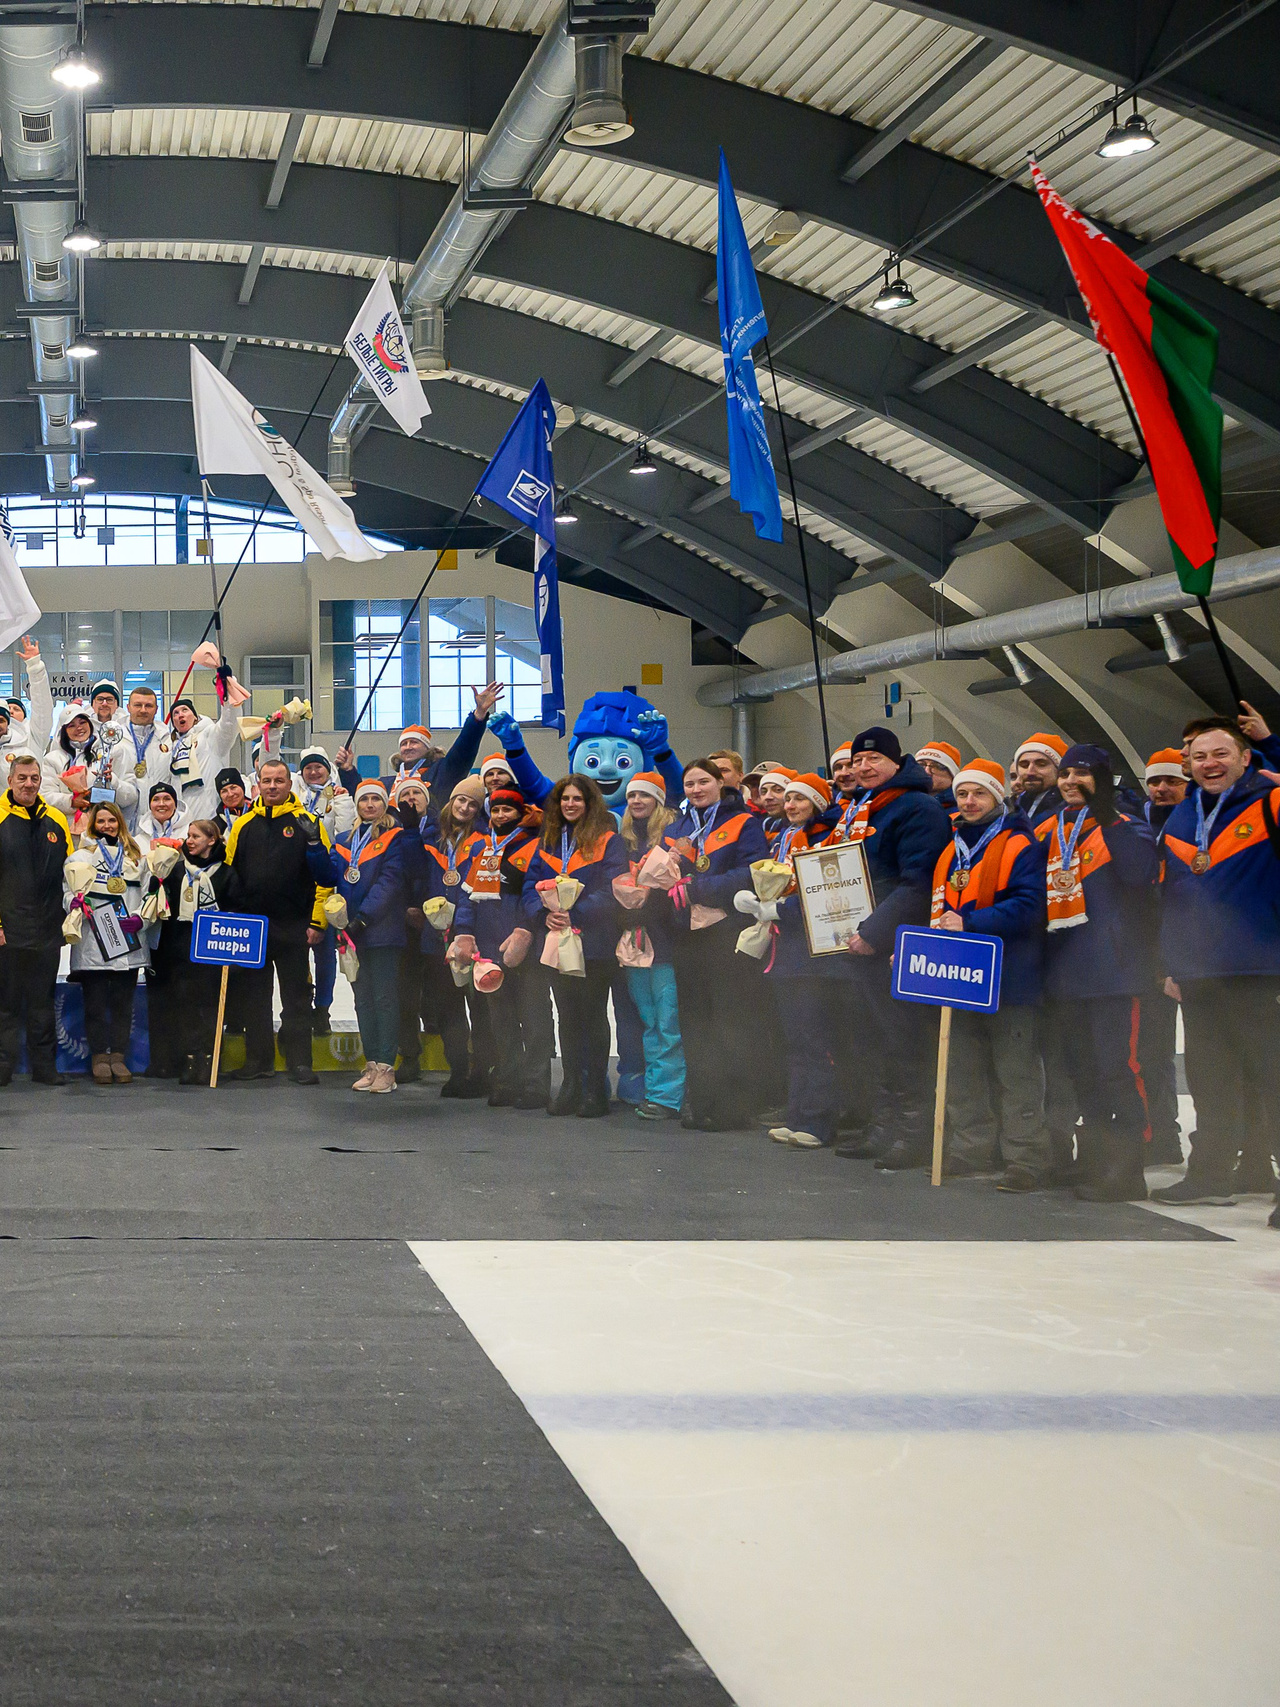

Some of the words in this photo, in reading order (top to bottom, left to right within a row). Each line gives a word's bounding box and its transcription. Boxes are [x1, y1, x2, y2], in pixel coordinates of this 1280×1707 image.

[353, 332, 380, 367] БЕЛЫЕ
[372, 364, 398, 396] ТИГРЫ
[805, 876, 863, 895] СЕРТИФИКАТ
[210, 921, 250, 938] Белые
[206, 939, 250, 956] тигры
[909, 954, 984, 985] Молния
